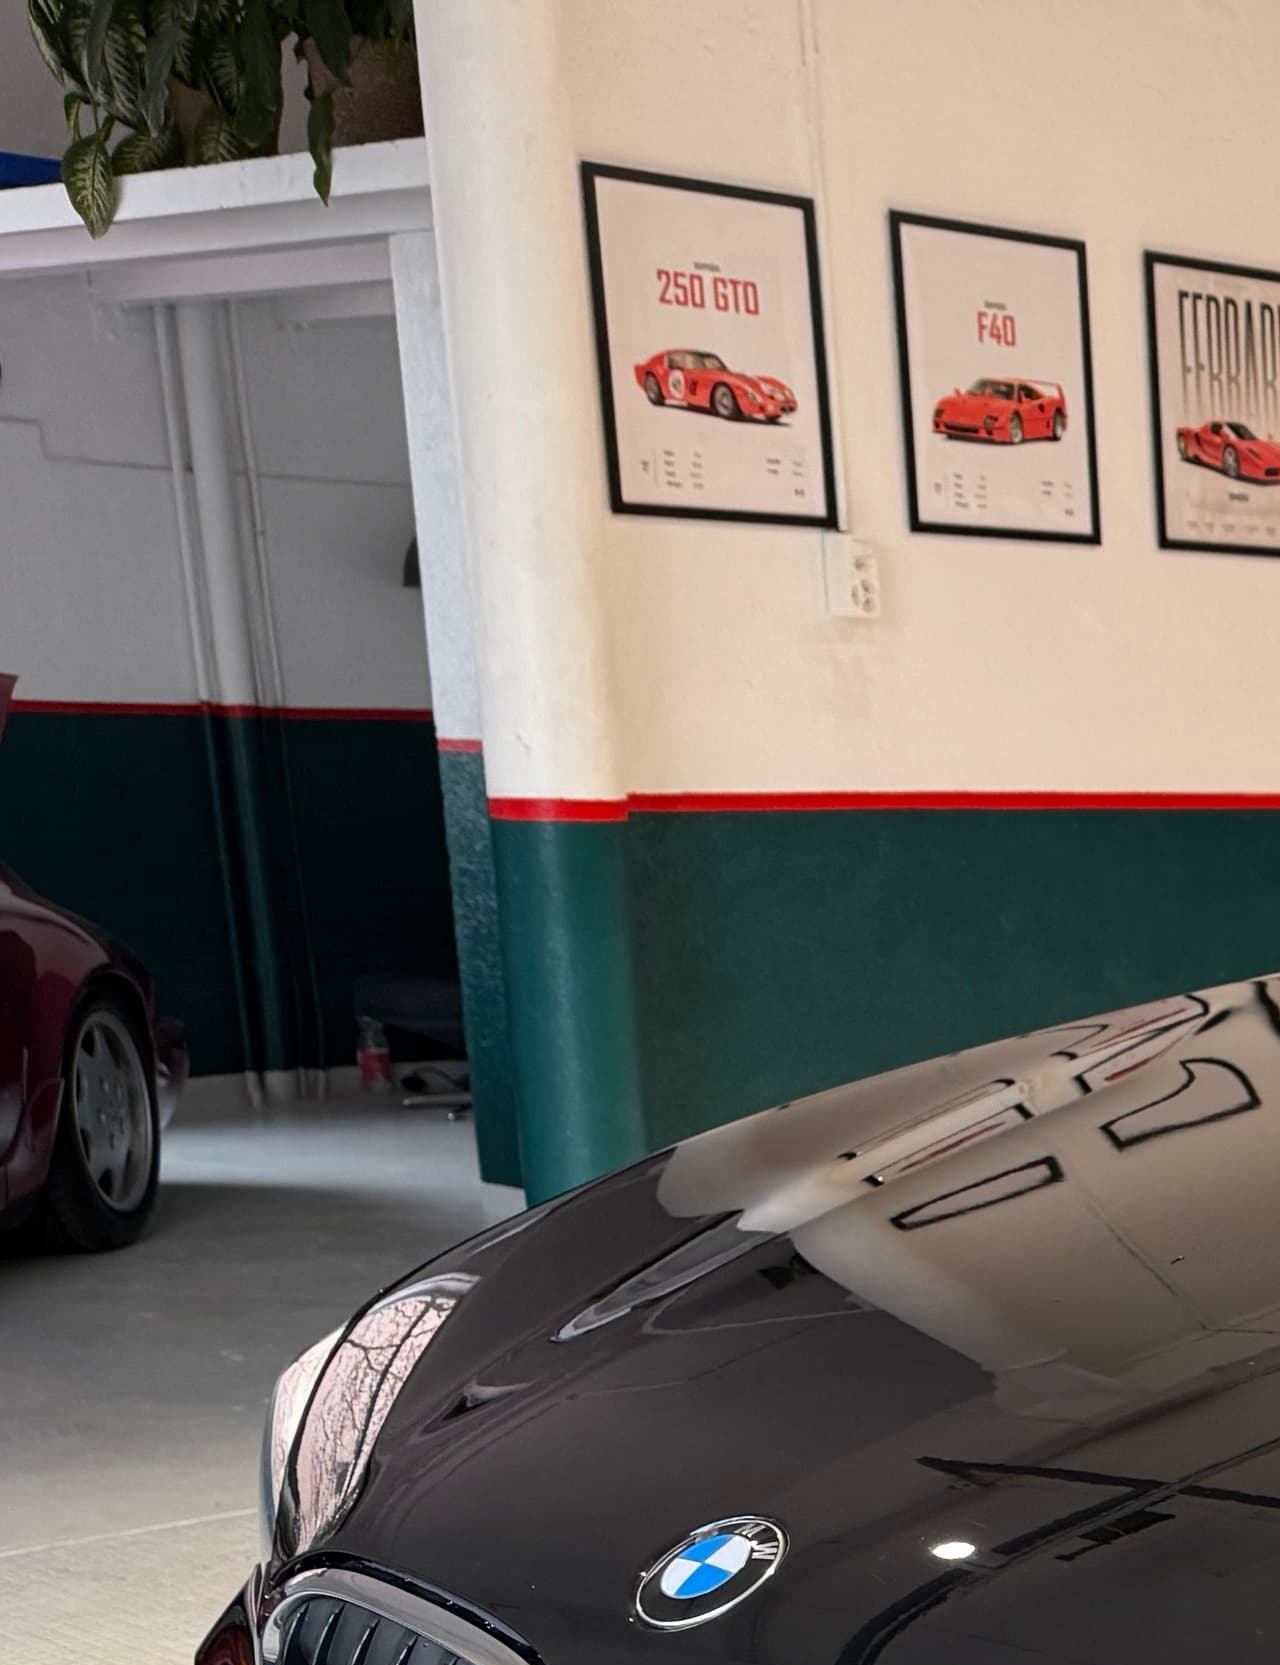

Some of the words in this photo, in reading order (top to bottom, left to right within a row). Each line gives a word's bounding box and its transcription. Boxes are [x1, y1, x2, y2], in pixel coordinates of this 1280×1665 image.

[657, 268, 705, 309] 250
[713, 276, 759, 315] GTO
[977, 311, 1016, 346] F40
